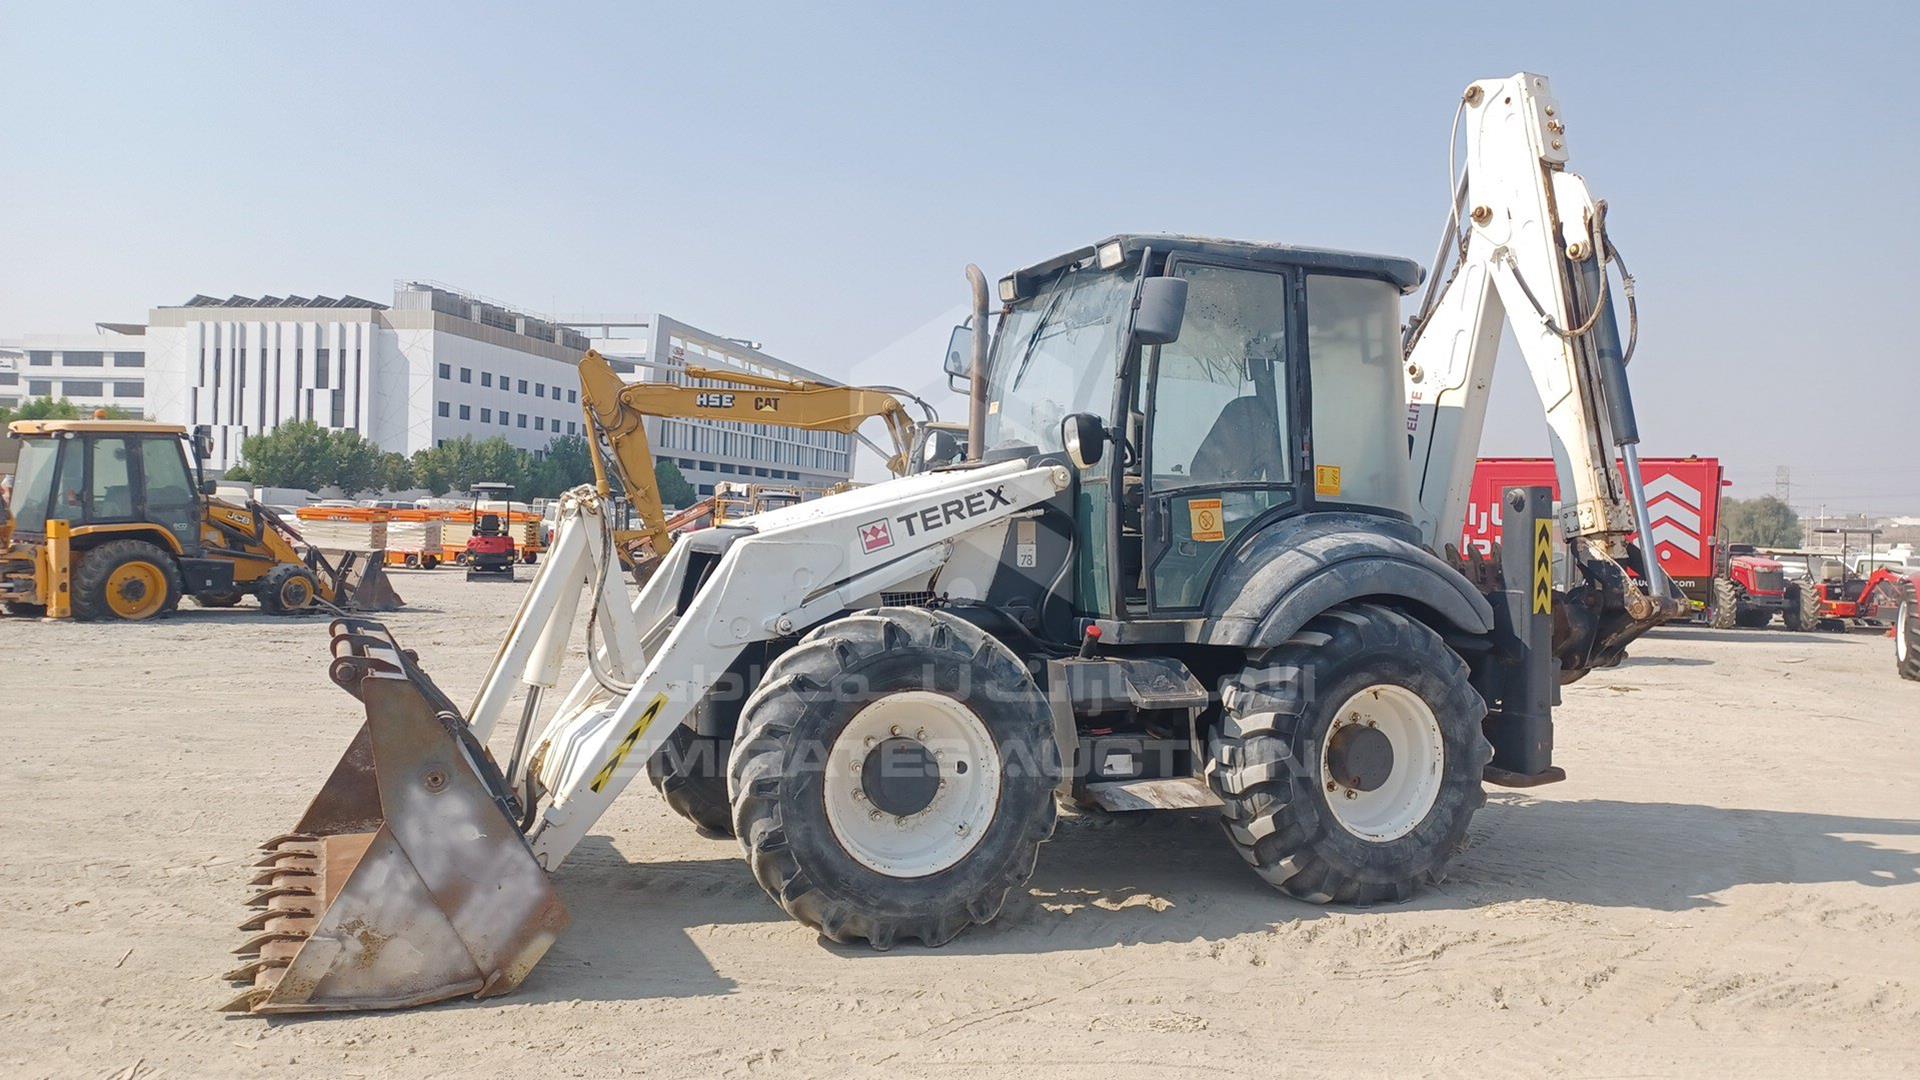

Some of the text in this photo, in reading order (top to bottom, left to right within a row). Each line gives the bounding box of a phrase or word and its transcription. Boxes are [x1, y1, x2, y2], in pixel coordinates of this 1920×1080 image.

[696, 393, 735, 408] HSE
[754, 397, 780, 411] CAT
[1407, 391, 1422, 431] ELITE
[226, 510, 250, 525] JCB
[897, 485, 1011, 536] TEREX
